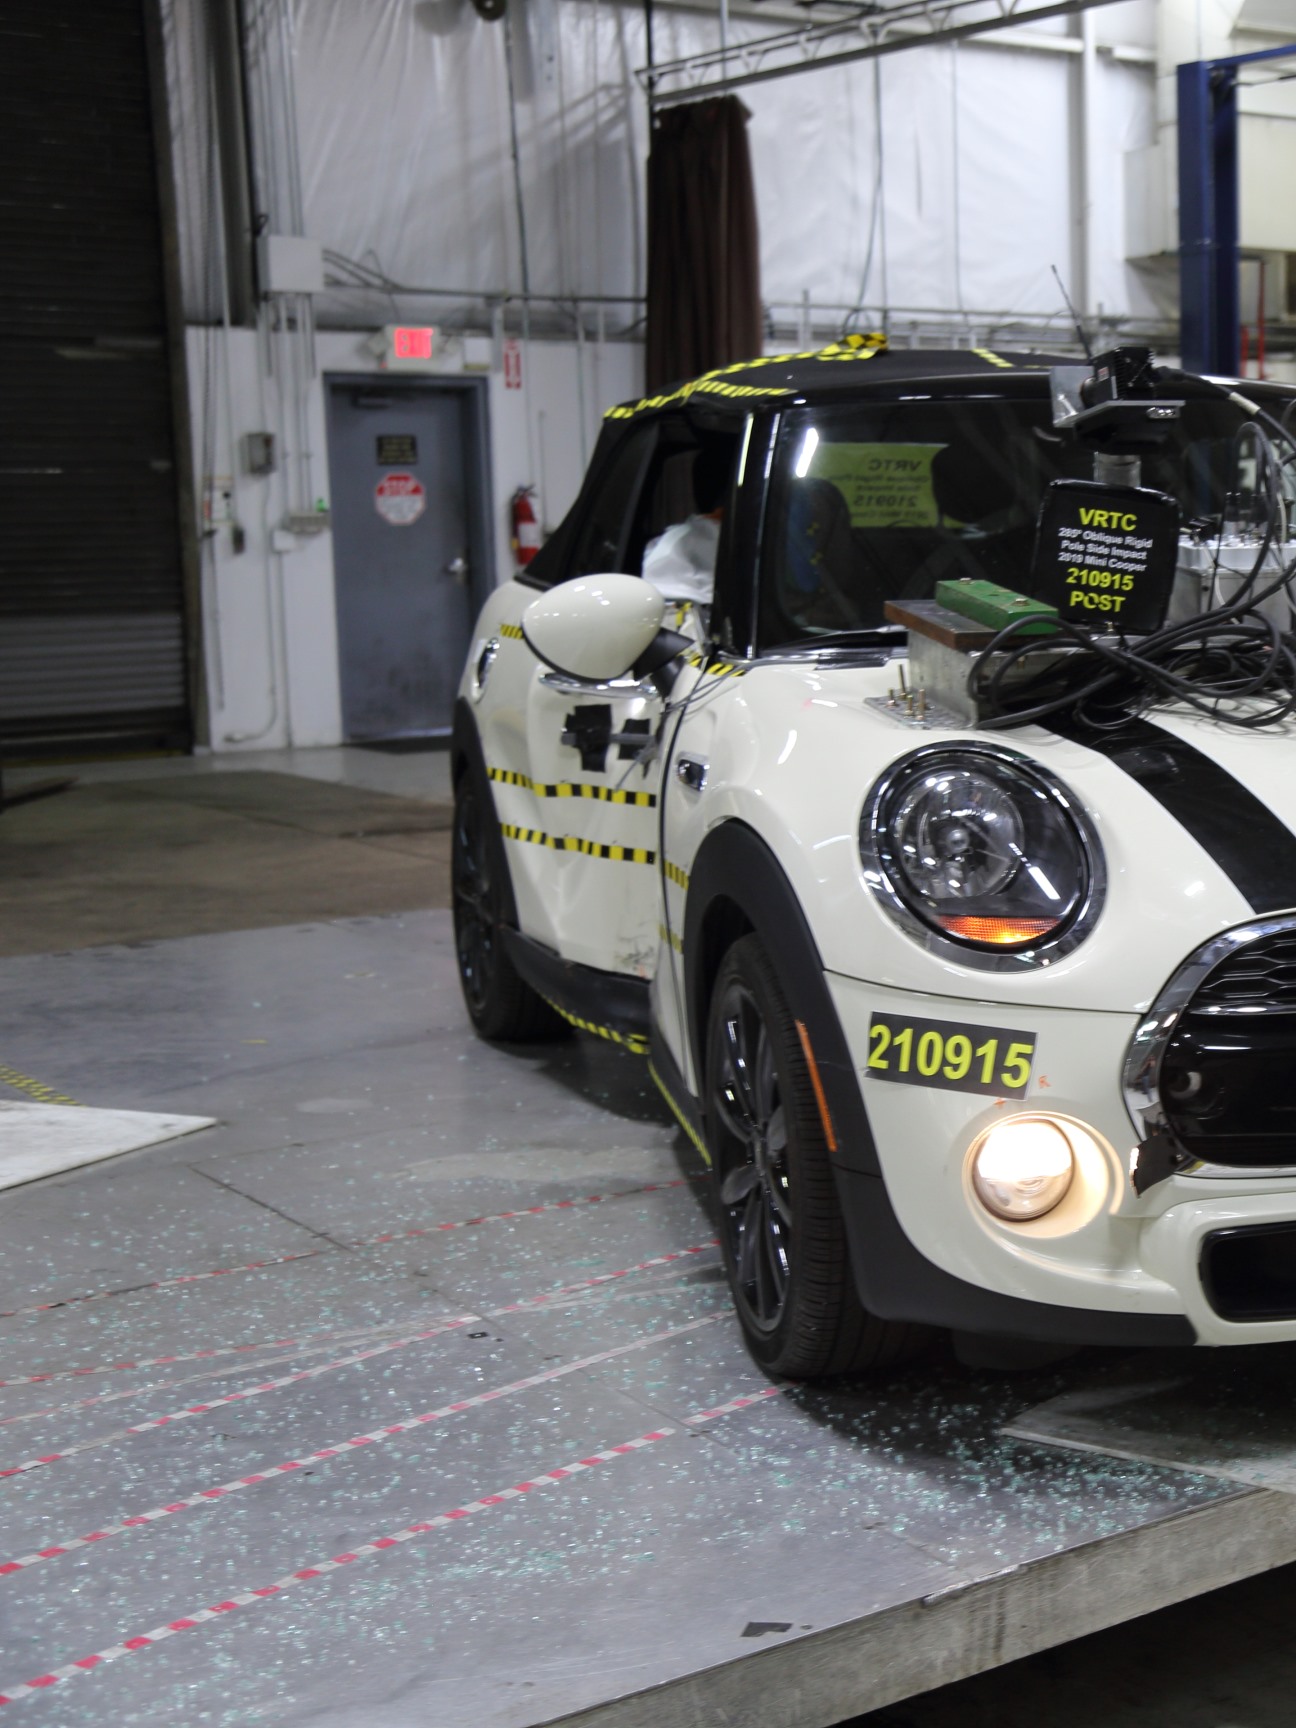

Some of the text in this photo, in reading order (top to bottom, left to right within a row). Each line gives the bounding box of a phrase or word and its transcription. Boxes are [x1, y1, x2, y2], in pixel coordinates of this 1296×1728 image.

[1079, 508, 1137, 531] VRTC
[1061, 540, 1147, 560] Pole Side Impact
[1082, 530, 1124, 544] Oblique
[1124, 535, 1153, 549] Rigid
[1058, 552, 1147, 572] 2019 Mini Cooper
[1066, 567, 1134, 591] 210915
[1070, 591, 1126, 612] POST
[867, 1024, 1034, 1088] 210915
